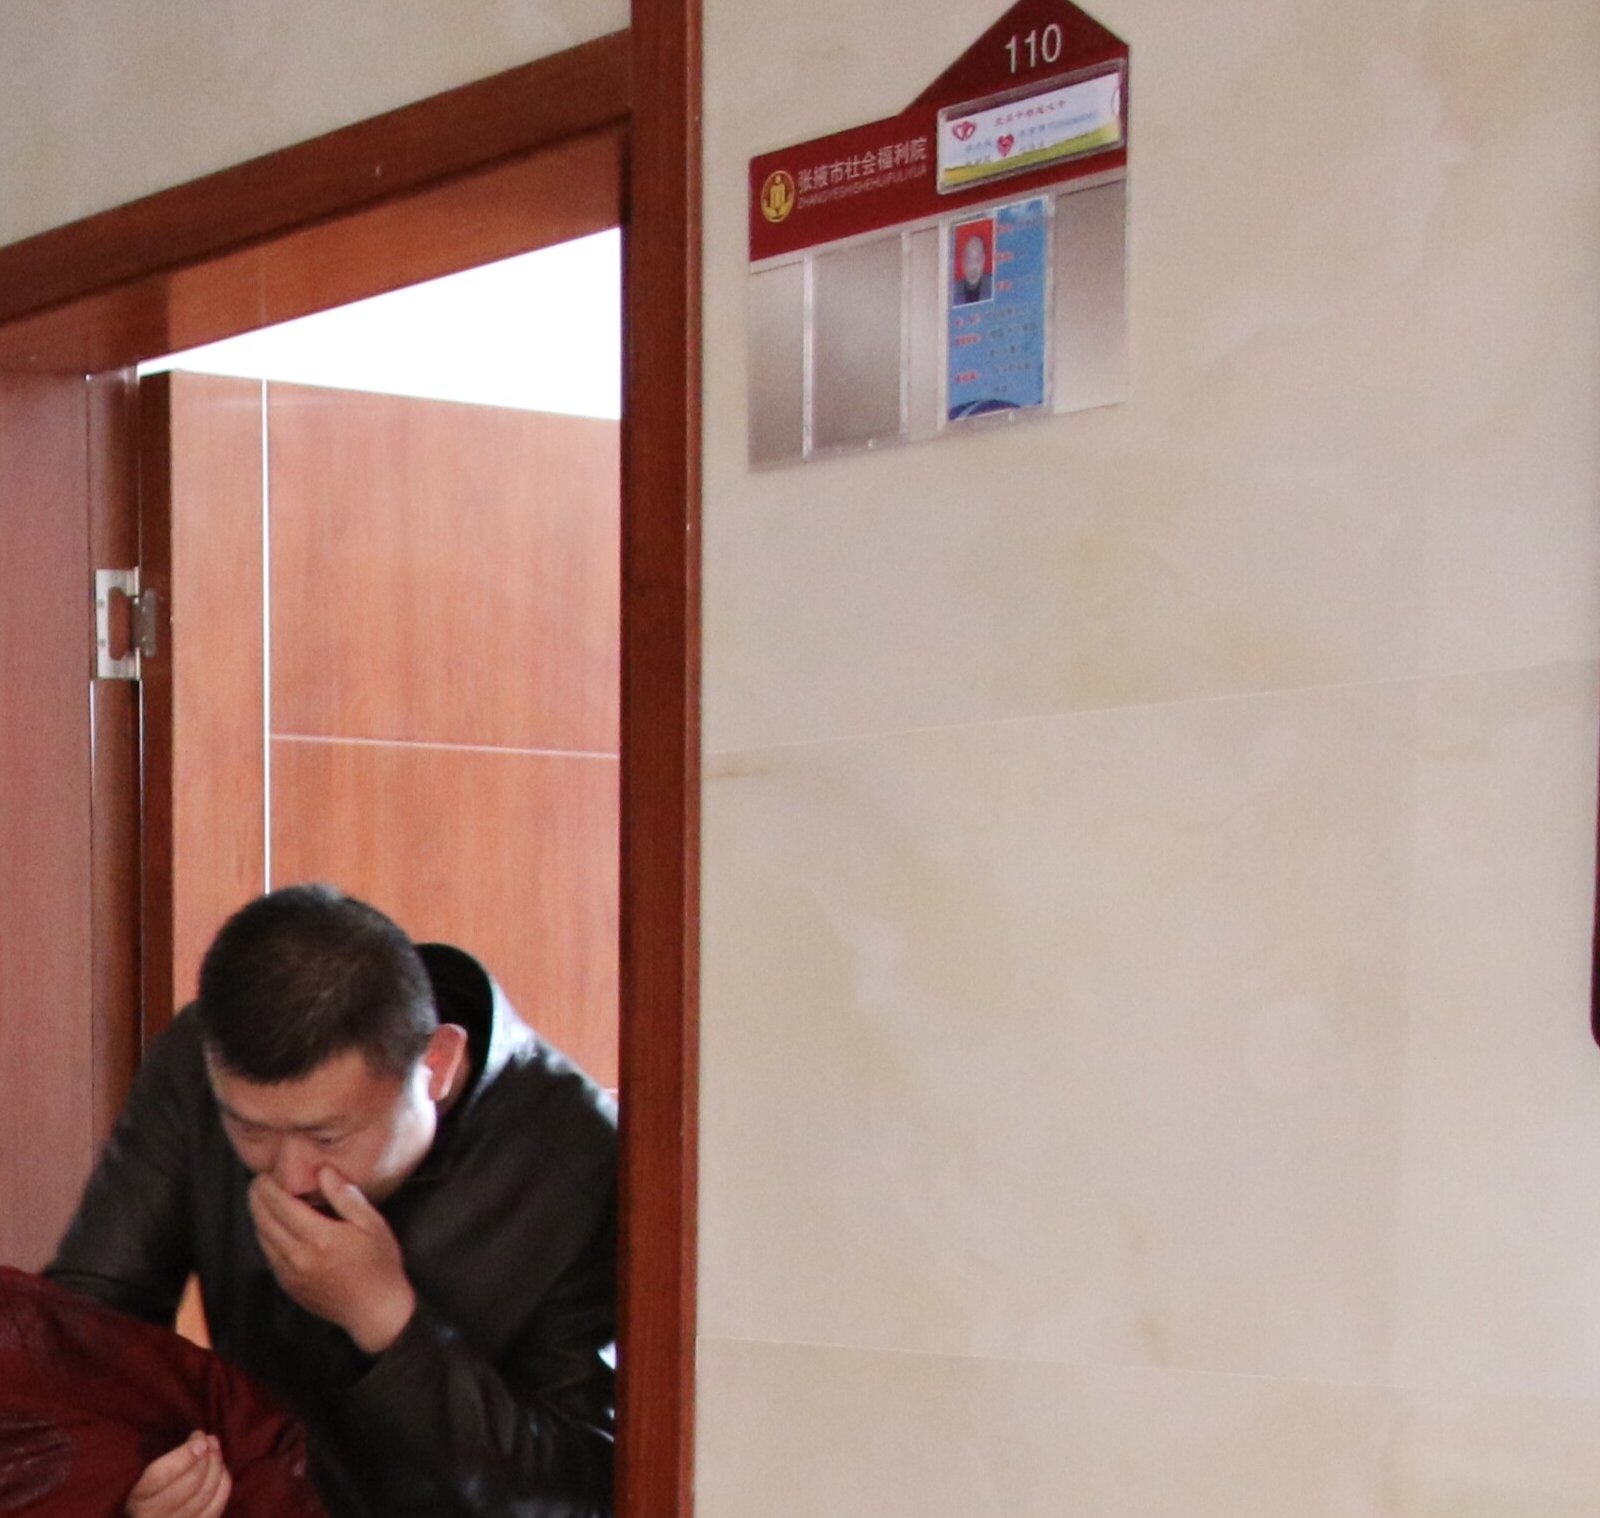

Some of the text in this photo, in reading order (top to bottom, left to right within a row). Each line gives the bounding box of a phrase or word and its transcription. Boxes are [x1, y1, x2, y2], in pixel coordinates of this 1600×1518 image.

[1004, 23, 1062, 74] 110
[797, 137, 928, 194] 张掖市社会福利院
